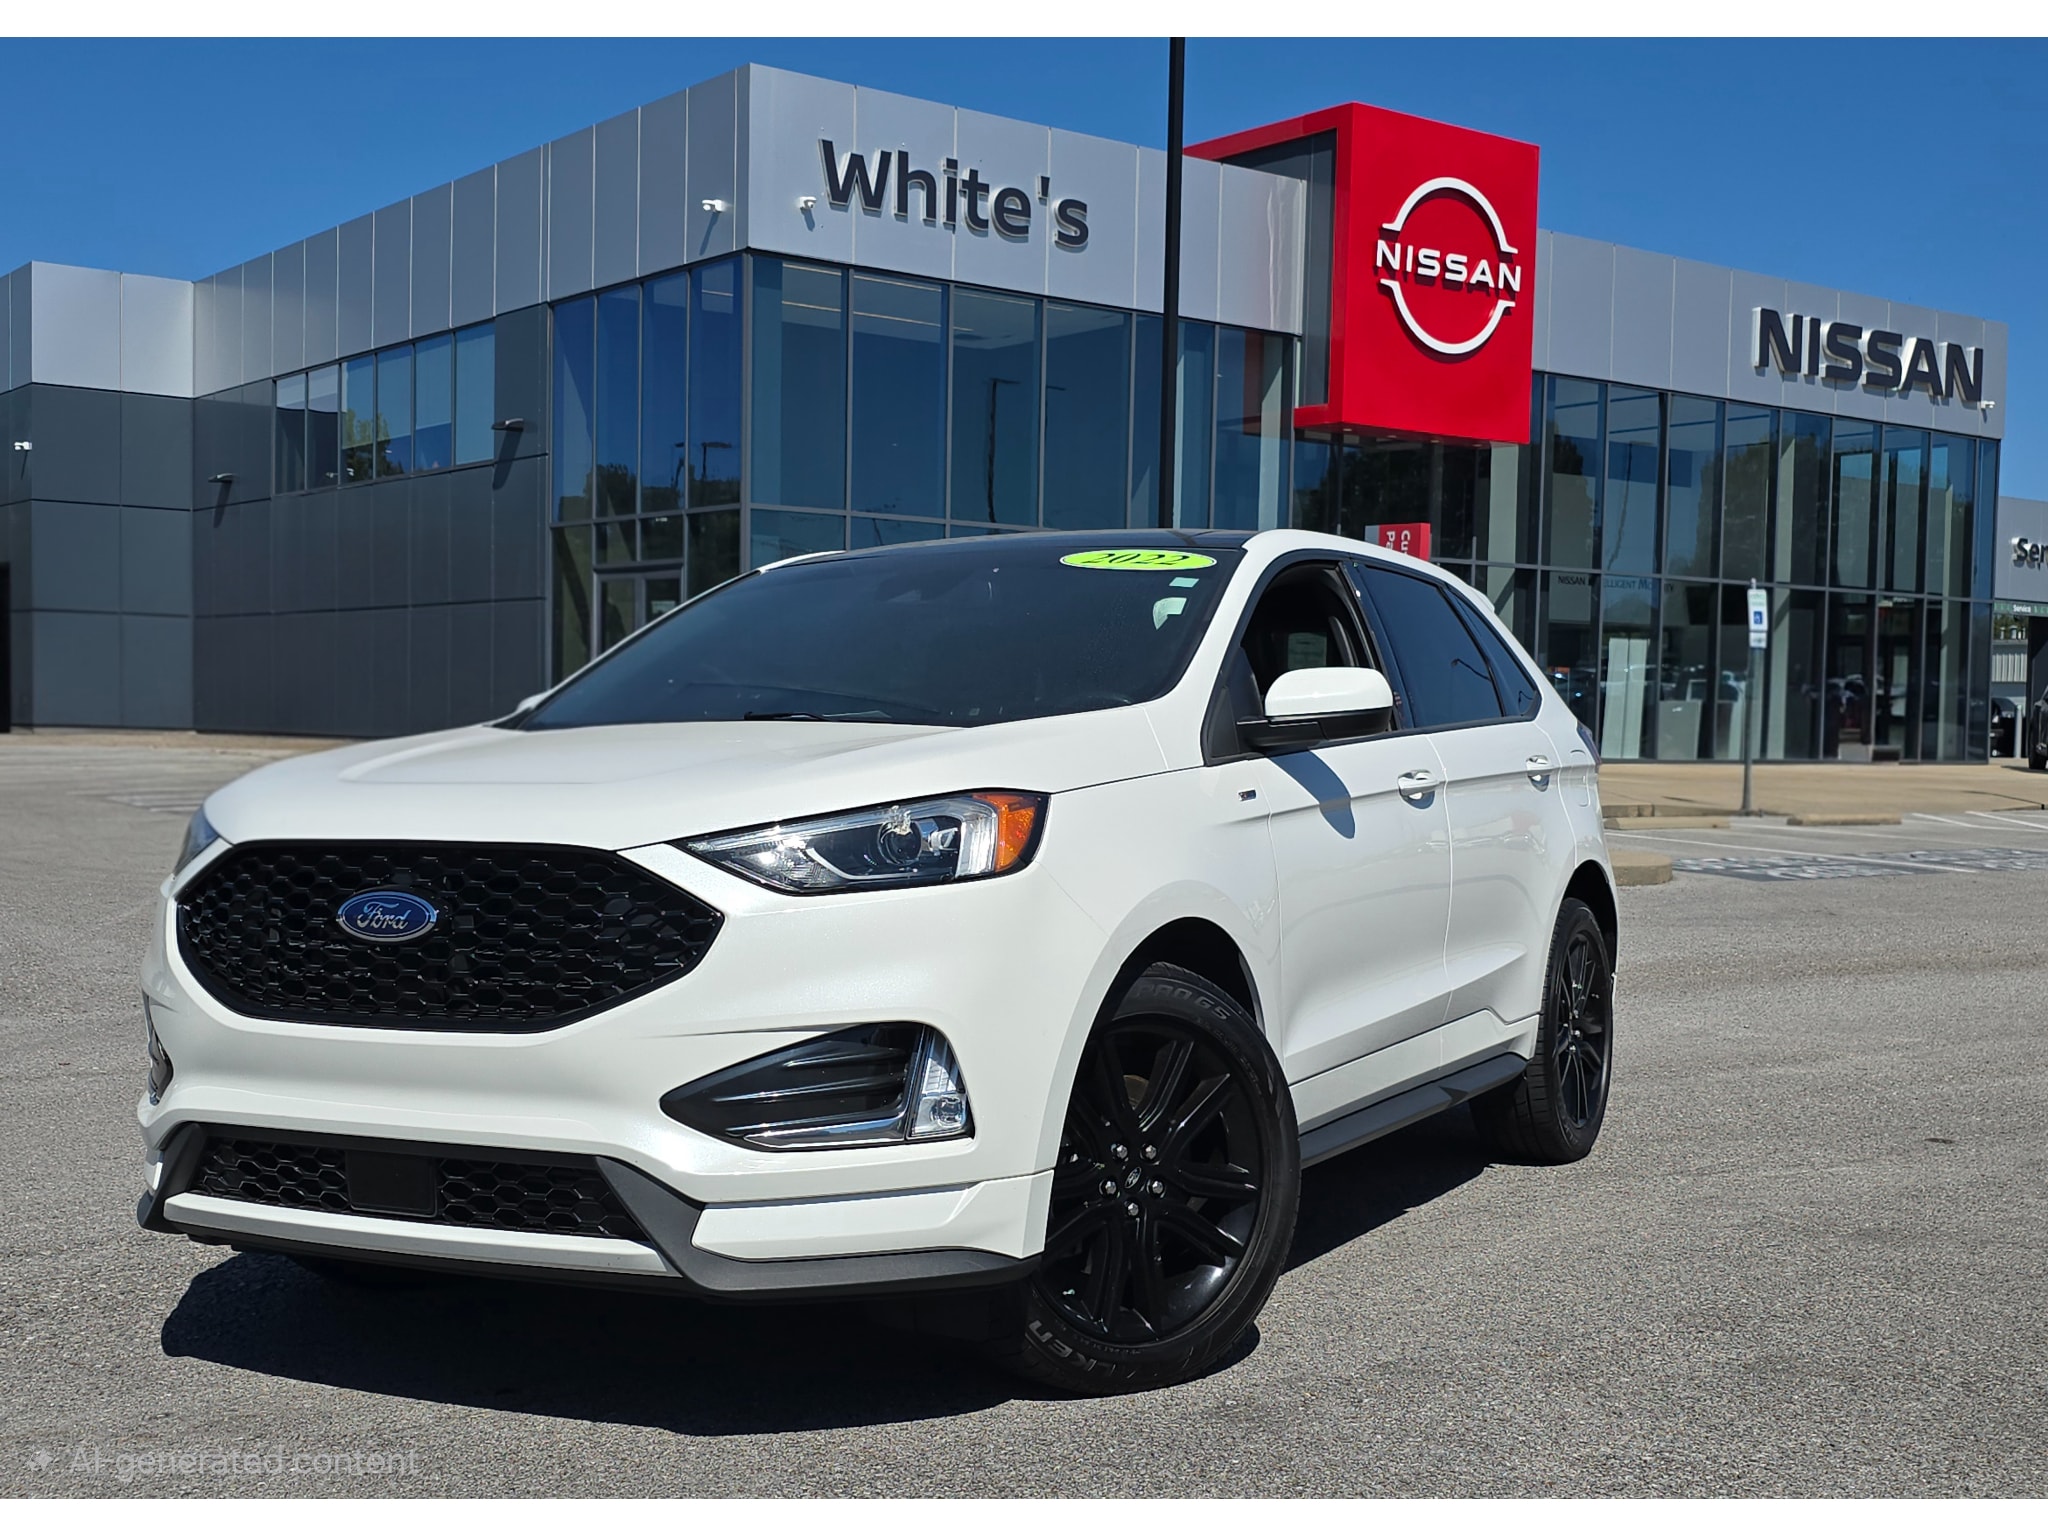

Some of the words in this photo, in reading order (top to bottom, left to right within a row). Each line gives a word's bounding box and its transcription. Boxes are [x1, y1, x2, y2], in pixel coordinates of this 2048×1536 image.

[818, 138, 1089, 247] White's
[1376, 239, 1521, 292] NISSAN
[1752, 307, 1983, 402] NISSAN
[1083, 553, 1190, 565] 2022
[357, 901, 412, 930] Ford
